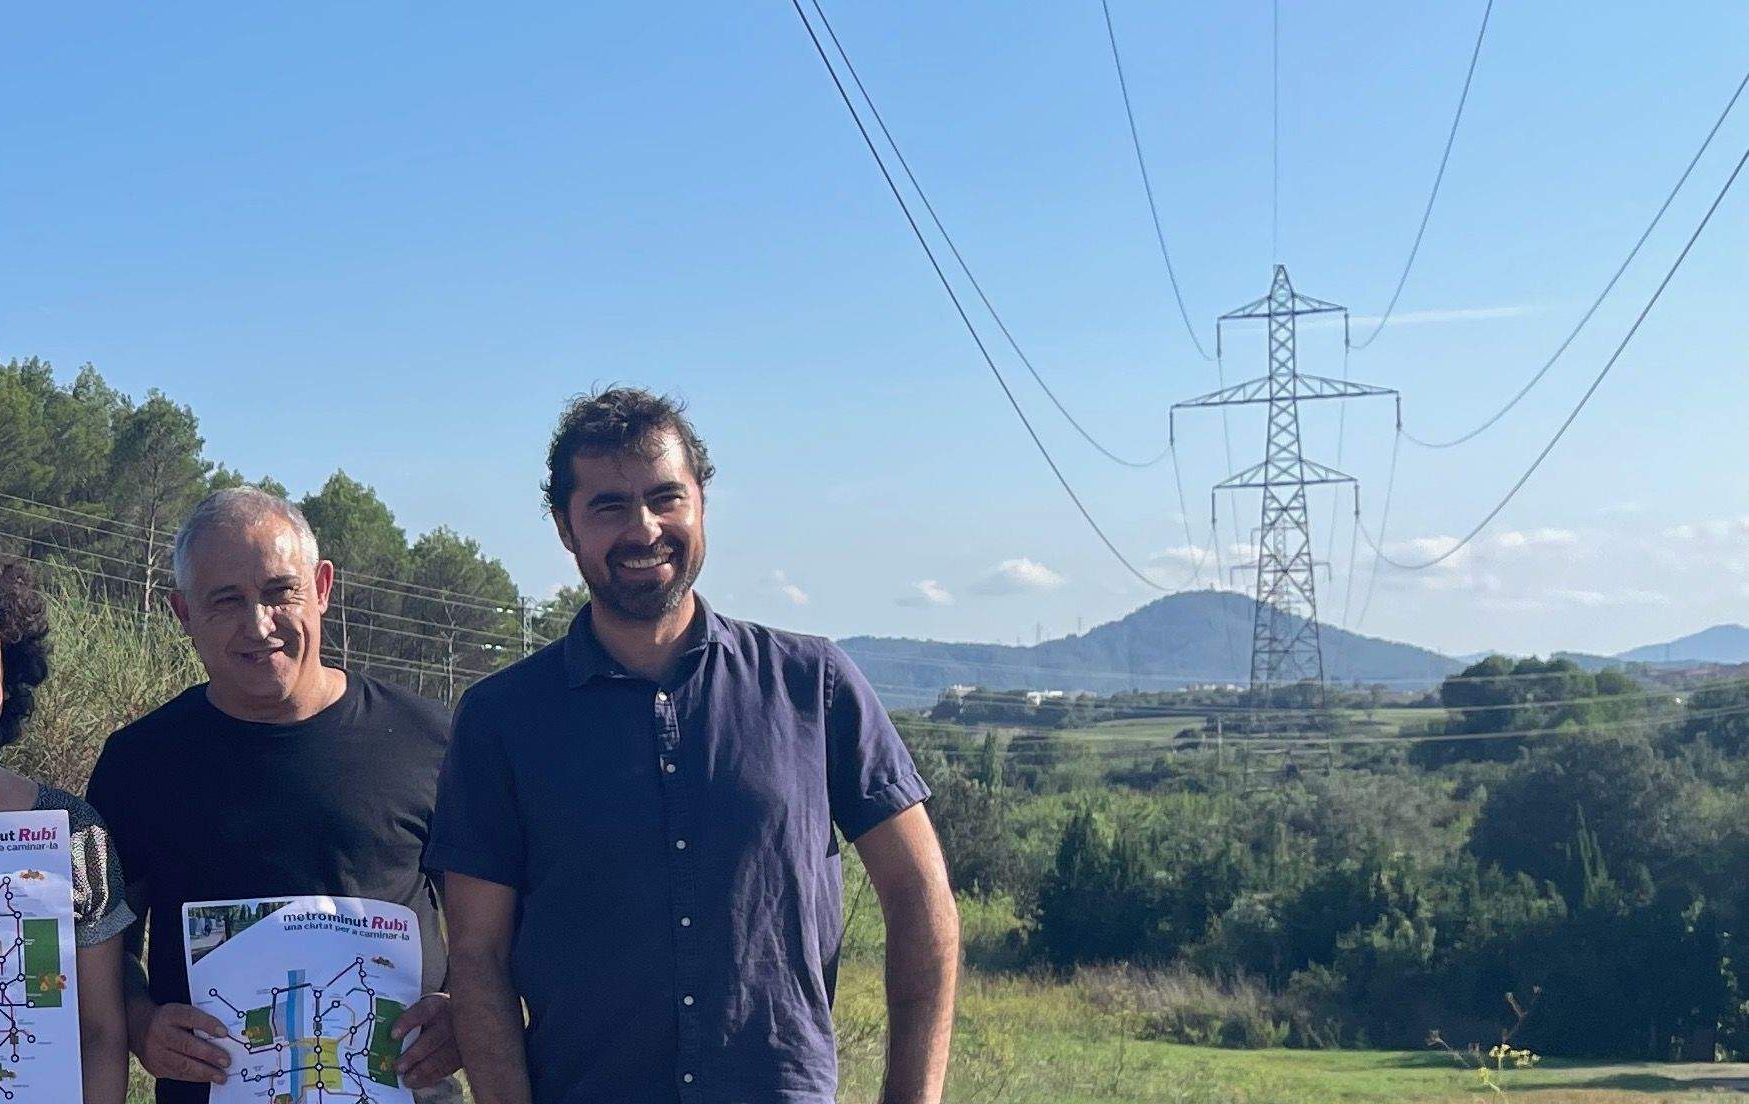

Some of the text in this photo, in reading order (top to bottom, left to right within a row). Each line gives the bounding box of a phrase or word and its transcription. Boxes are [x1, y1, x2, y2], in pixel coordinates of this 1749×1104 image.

[18, 827, 58, 841] Rubí
[284, 911, 408, 931] metrominut Rubí
